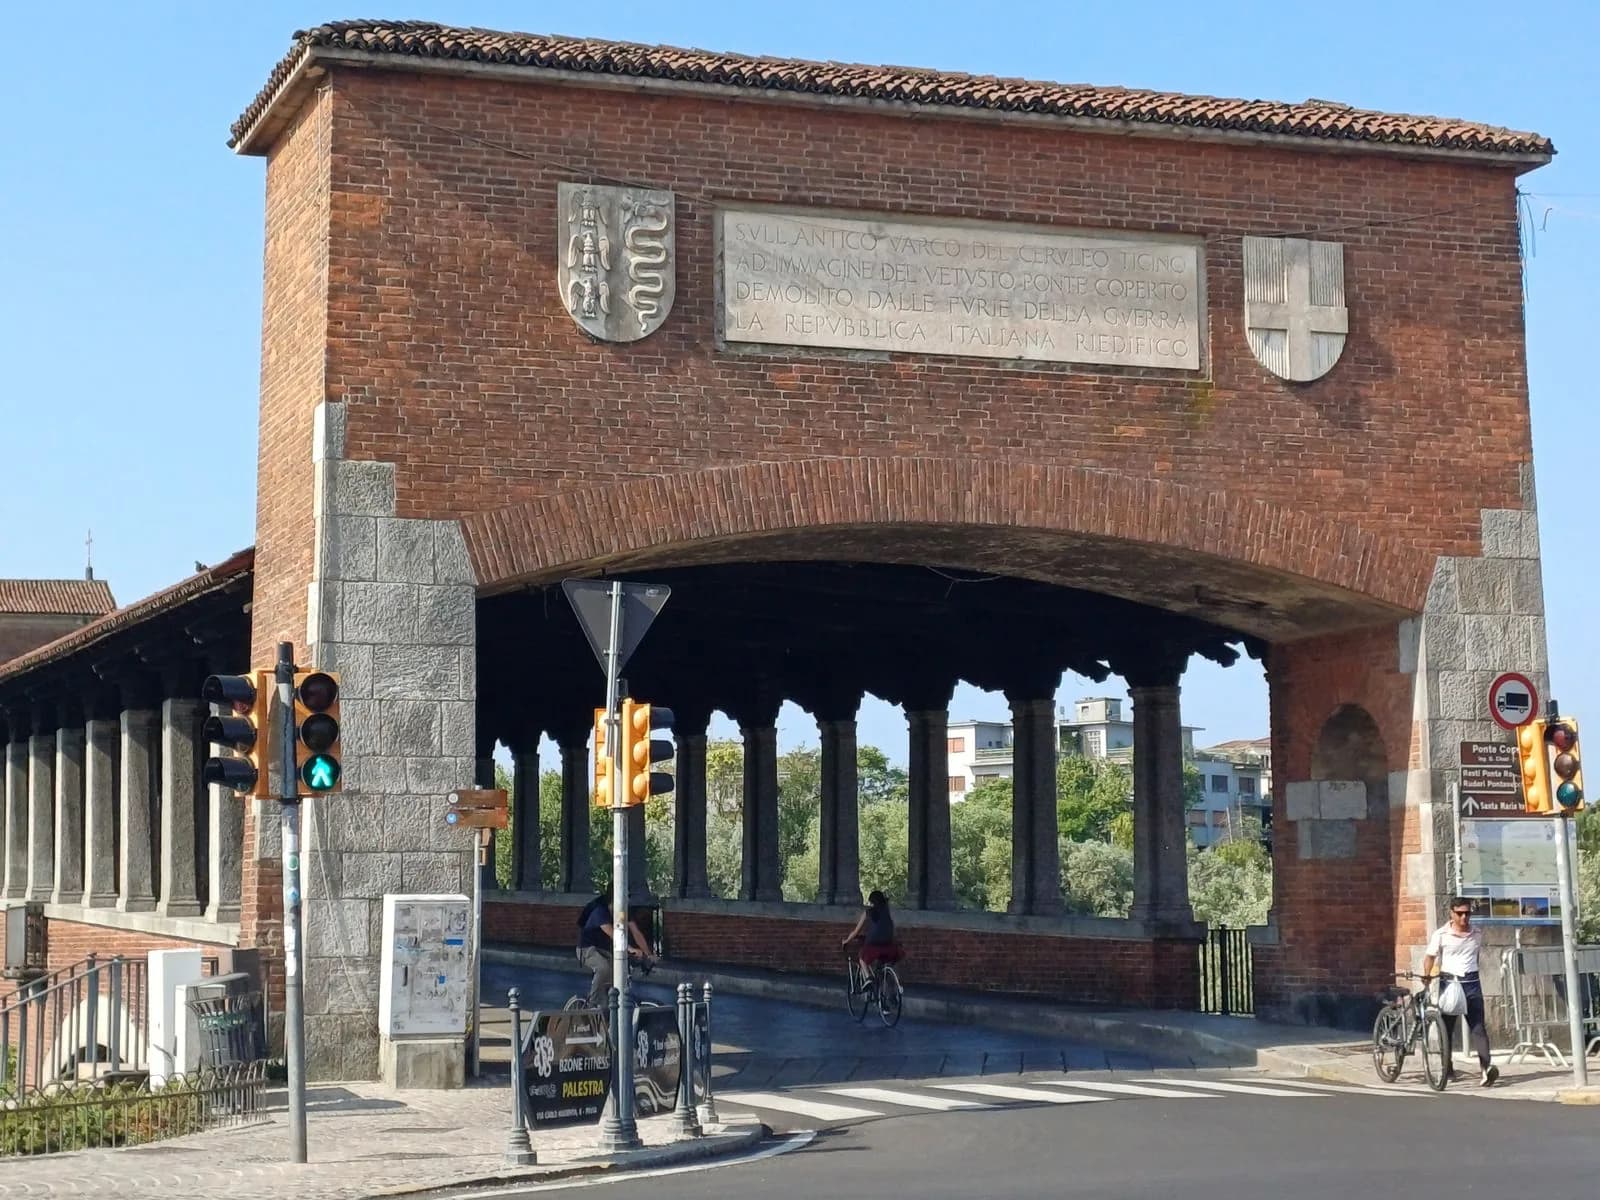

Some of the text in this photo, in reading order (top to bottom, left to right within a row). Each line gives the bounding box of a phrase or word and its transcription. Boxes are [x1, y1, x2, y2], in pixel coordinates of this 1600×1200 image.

[794, 226, 877, 251] ANTICO
[891, 237, 960, 257] VARCO
[973, 240, 1009, 261] DEL
[1018, 244, 1109, 268] CERVLEO
[1120, 251, 1187, 274] TICINO
[736, 253, 1188, 302] AD IMMAGINE DEL VETVSTO PONTE COPERTO
[736, 282, 1187, 330] DEMOLITO DALLE FVRIE DELLA GVERRA
[736, 312, 1189, 358] LA REPVBBLICA ITALIANA RIEDIFICO
[1472, 744, 1497, 754] Ponte
[1480, 801, 1498, 810] Santa
[584, 1055, 609, 1071] FITNESS
[562, 1080, 604, 1098] PALESTRA
